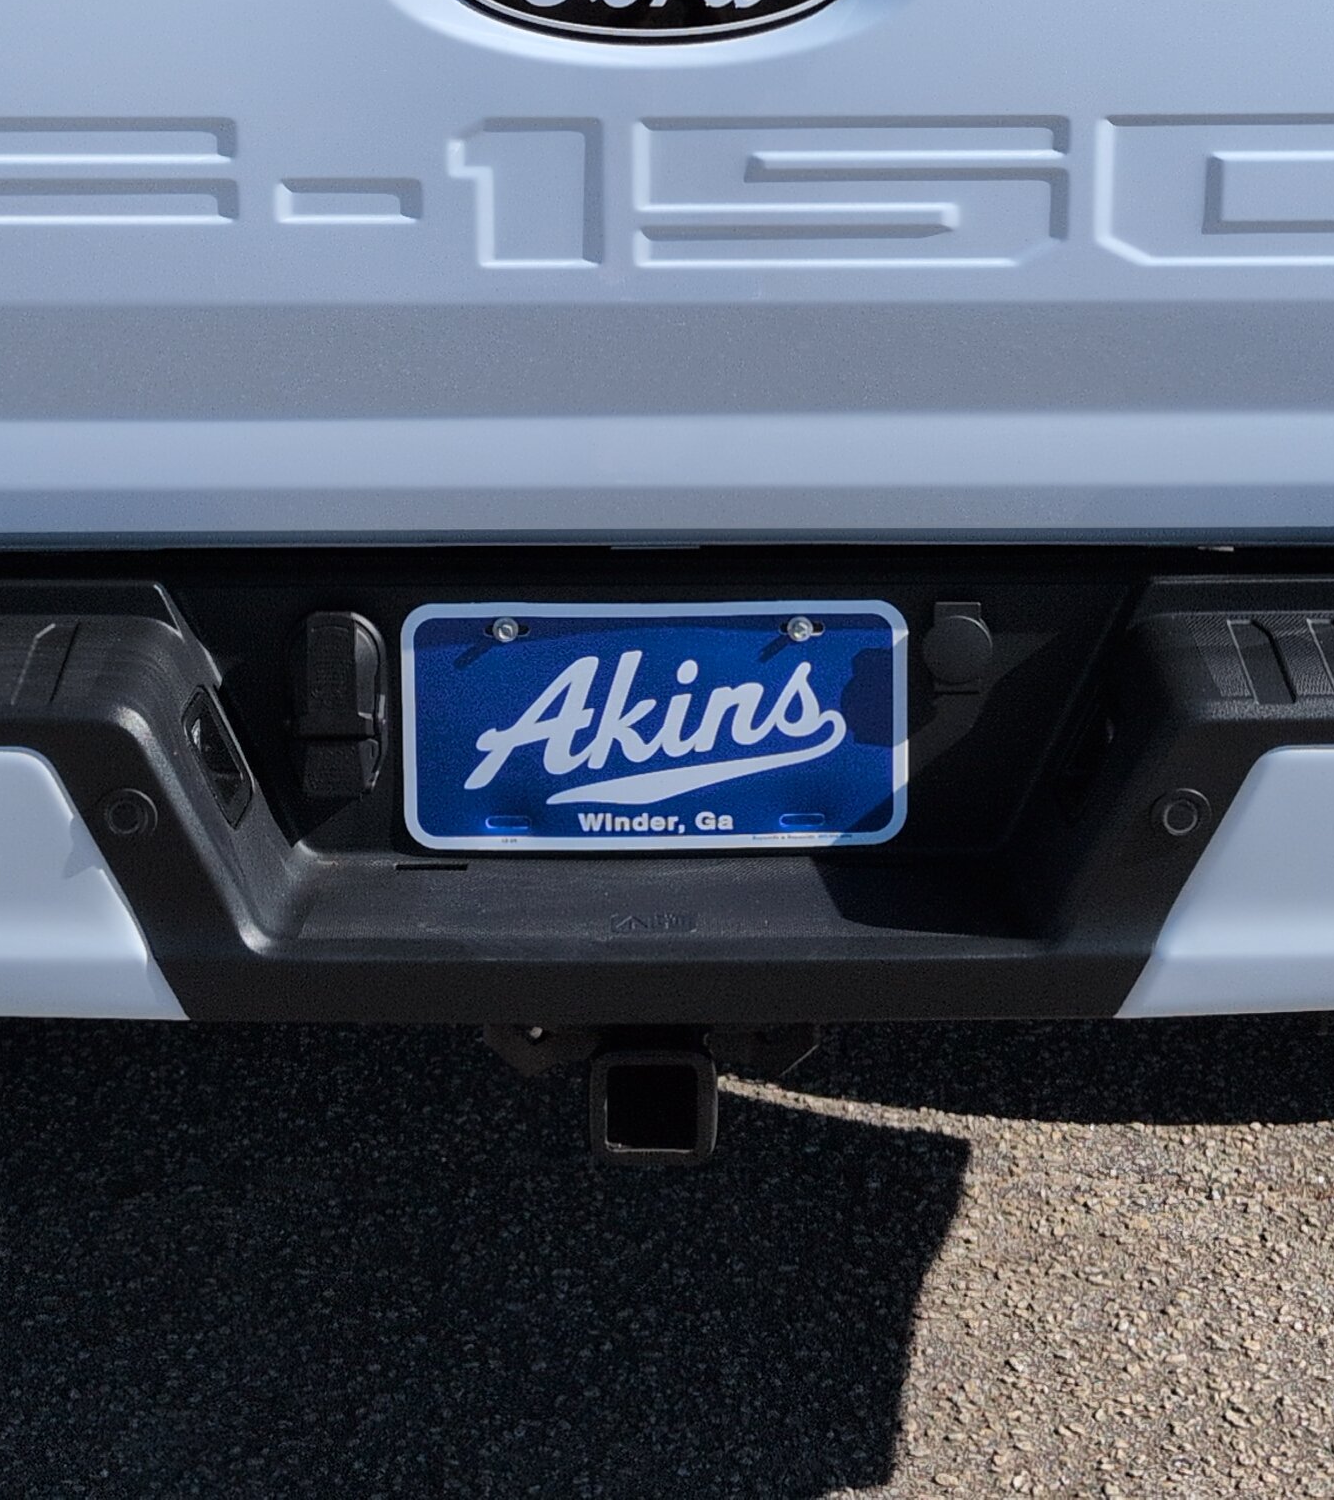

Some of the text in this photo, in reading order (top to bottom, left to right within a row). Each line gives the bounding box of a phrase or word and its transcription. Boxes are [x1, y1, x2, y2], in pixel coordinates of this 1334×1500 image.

[464, 650, 847, 805] Akins
[578, 811, 734, 834] Winder, Ga
